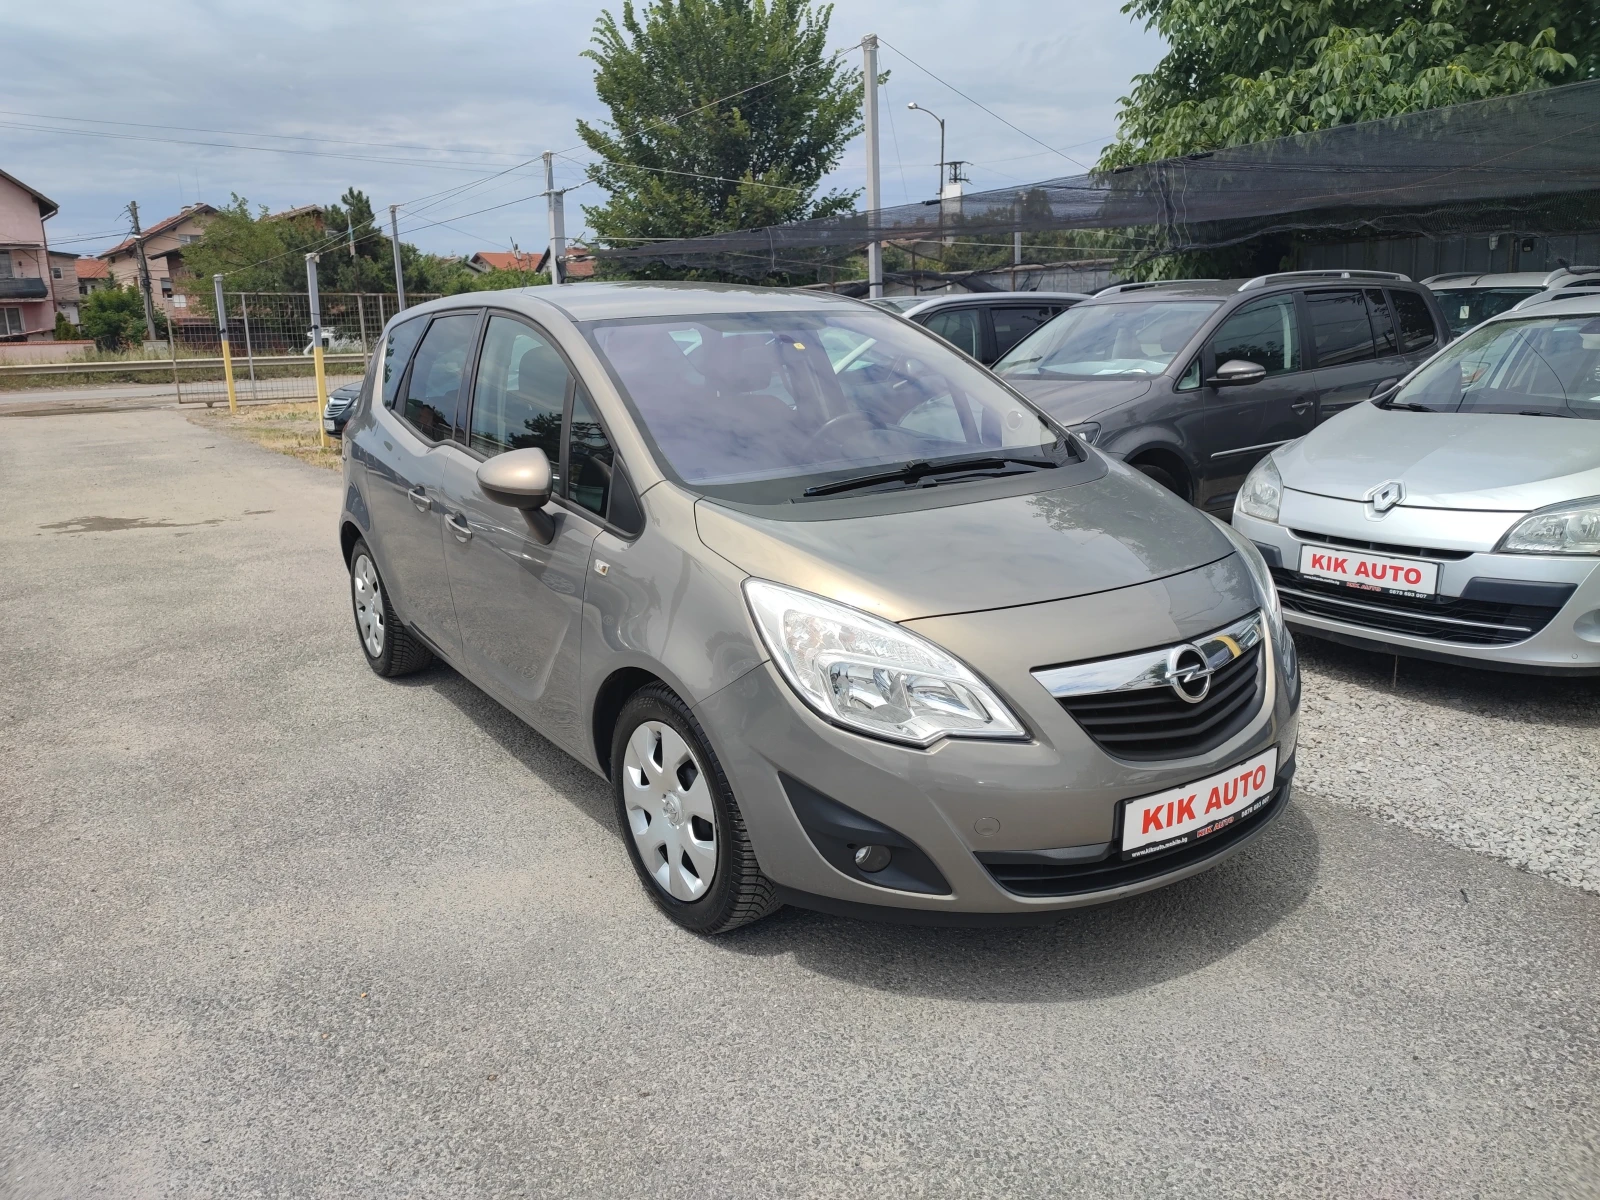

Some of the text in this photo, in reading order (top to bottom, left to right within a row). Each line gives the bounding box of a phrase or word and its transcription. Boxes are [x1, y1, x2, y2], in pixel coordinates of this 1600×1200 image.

[1311, 553, 1422, 585] KIK AUTO
[1142, 765, 1266, 835] KIK AUTO
[1197, 817, 1234, 838] KIK AUTO
